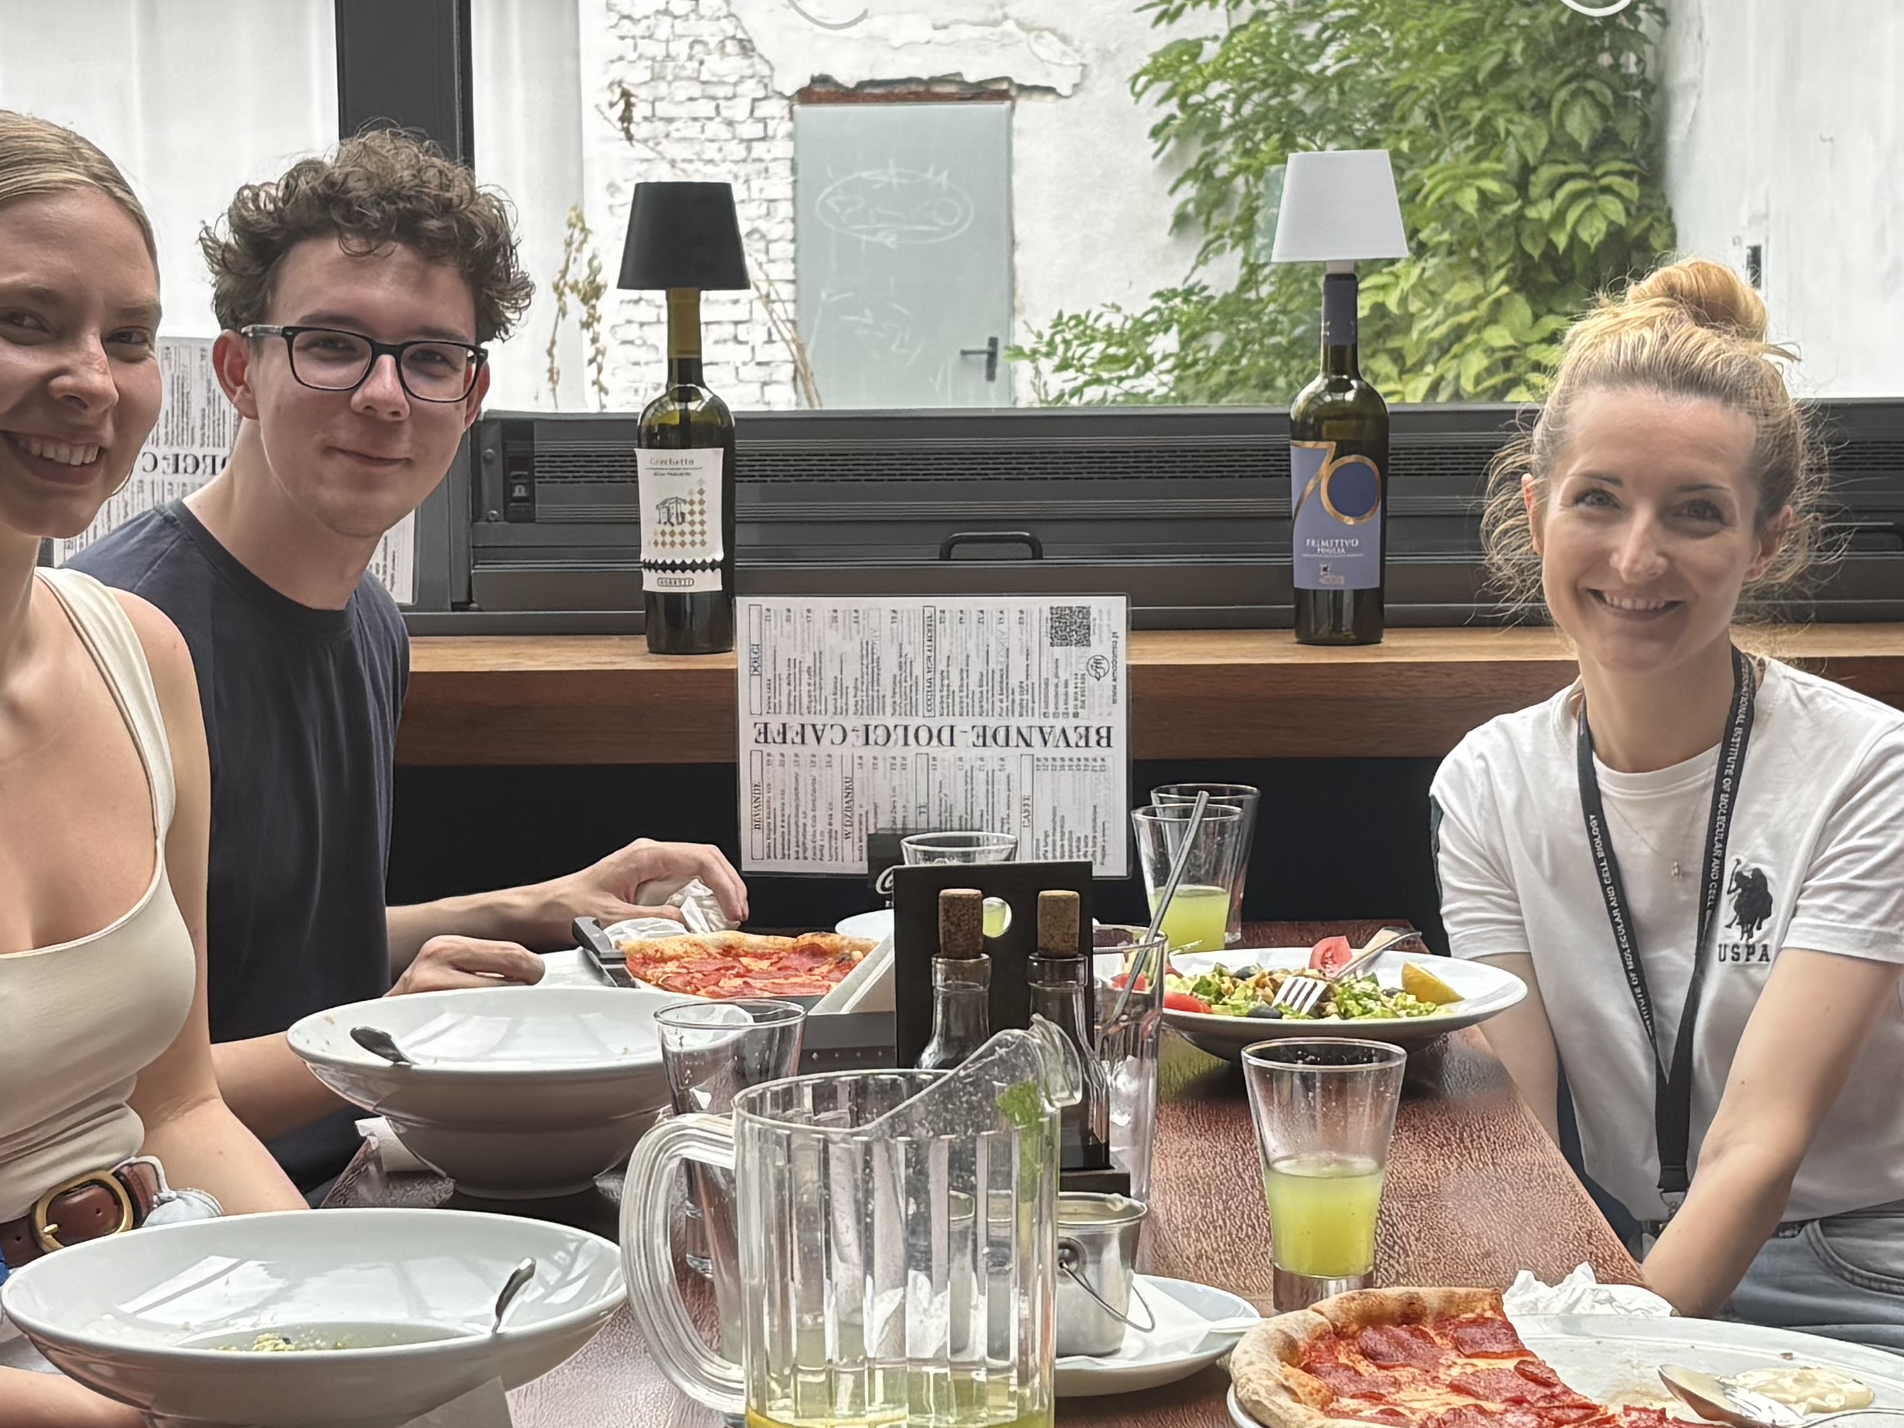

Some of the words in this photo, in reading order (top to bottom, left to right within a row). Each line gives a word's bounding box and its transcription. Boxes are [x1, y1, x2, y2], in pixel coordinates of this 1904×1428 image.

[1305, 538, 1359, 547] PRIMITIVO
[1722, 778, 1732, 792] OF
[1589, 814, 1607, 858] BIOLOGY
[1712, 794, 1729, 857] MOLECULAR
[1600, 859, 1613, 884] CELL
[1710, 858, 1720, 880] AND
[1607, 886, 1619, 907] AND
[1705, 883, 1718, 907] CELL
[1612, 908, 1637, 969] MOLECULAR
[1717, 942, 1771, 964] USPA
